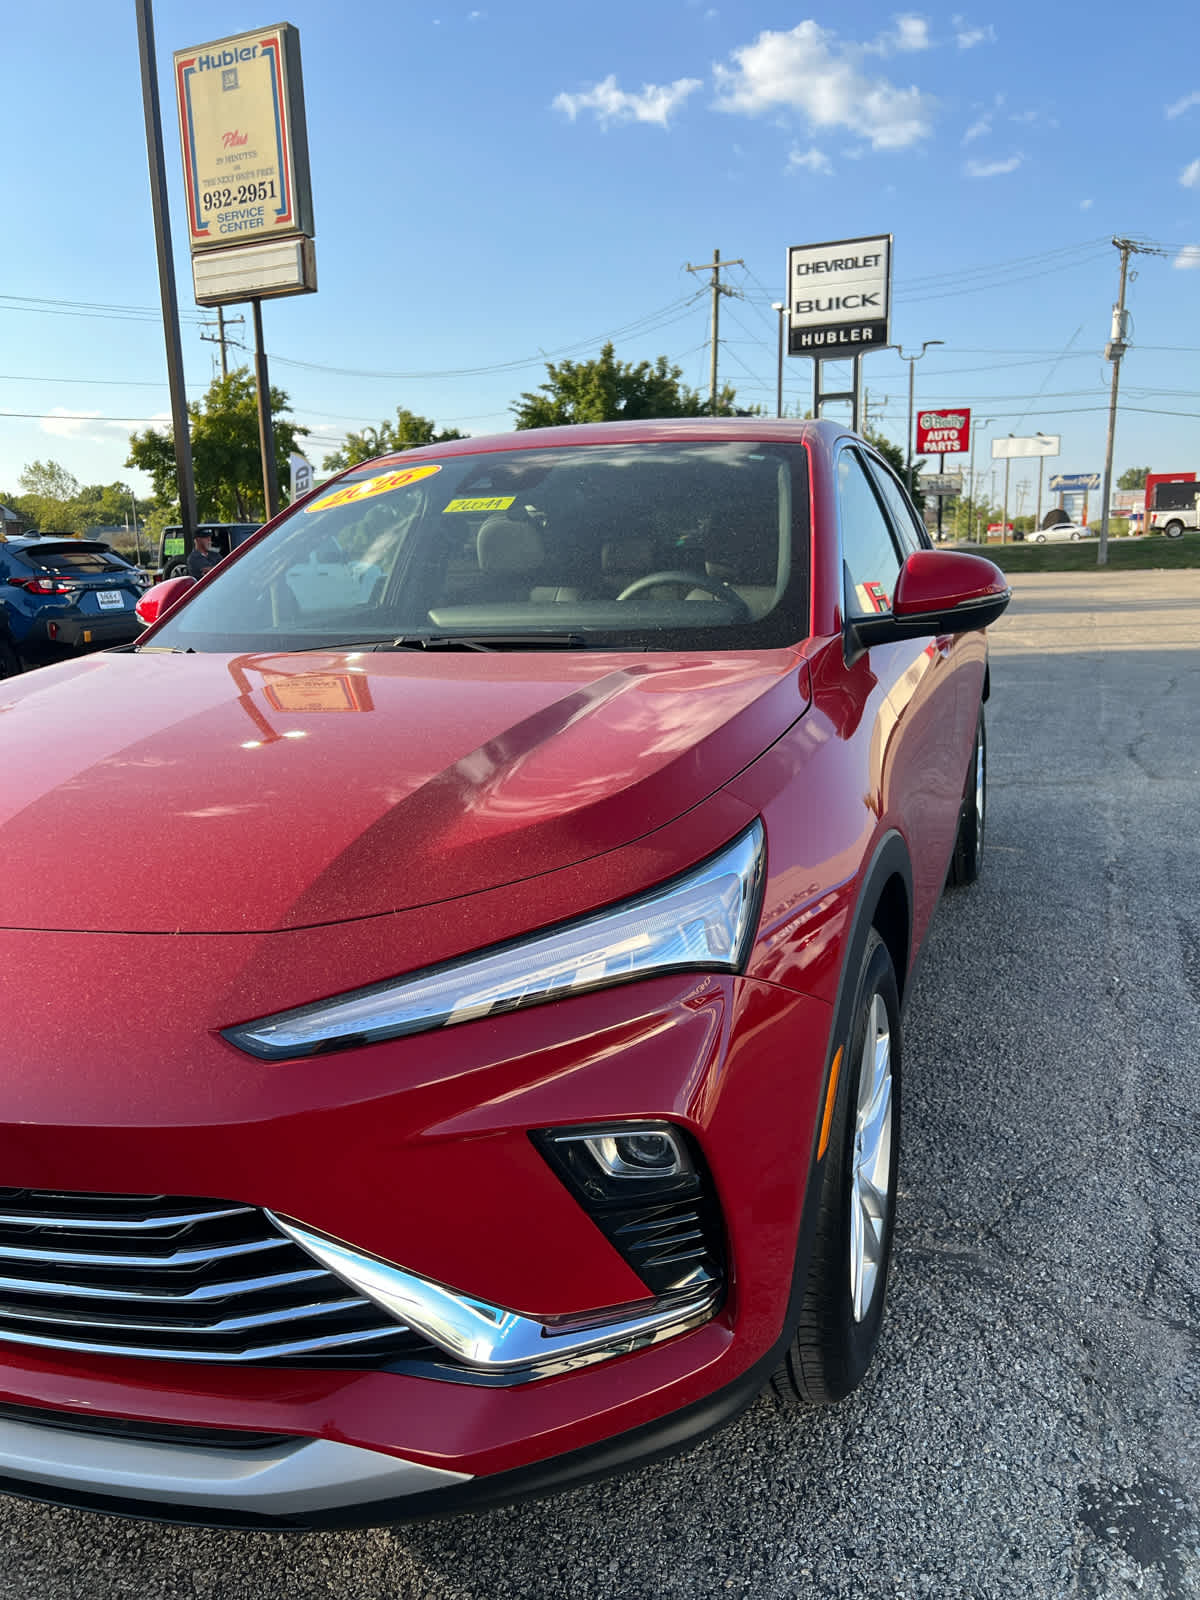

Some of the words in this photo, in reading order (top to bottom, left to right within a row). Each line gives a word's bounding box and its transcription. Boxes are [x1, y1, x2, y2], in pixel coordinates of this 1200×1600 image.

[198, 45, 258, 72] Hubler
[222, 129, 248, 149] Plus
[225, 150, 257, 163] MINUTES
[217, 175, 235, 186] NEXT
[256, 167, 275, 178] FREE
[203, 179, 276, 212] 932-2951
[217, 206, 264, 223] SERVICE
[219, 218, 264, 234] CENTER
[796, 254, 882, 276] CHEVROLET
[796, 292, 881, 314] BUICK
[801, 328, 873, 346] HUBLER
[927, 430, 959, 441] AUTO
[923, 440, 960, 452] PARTS
